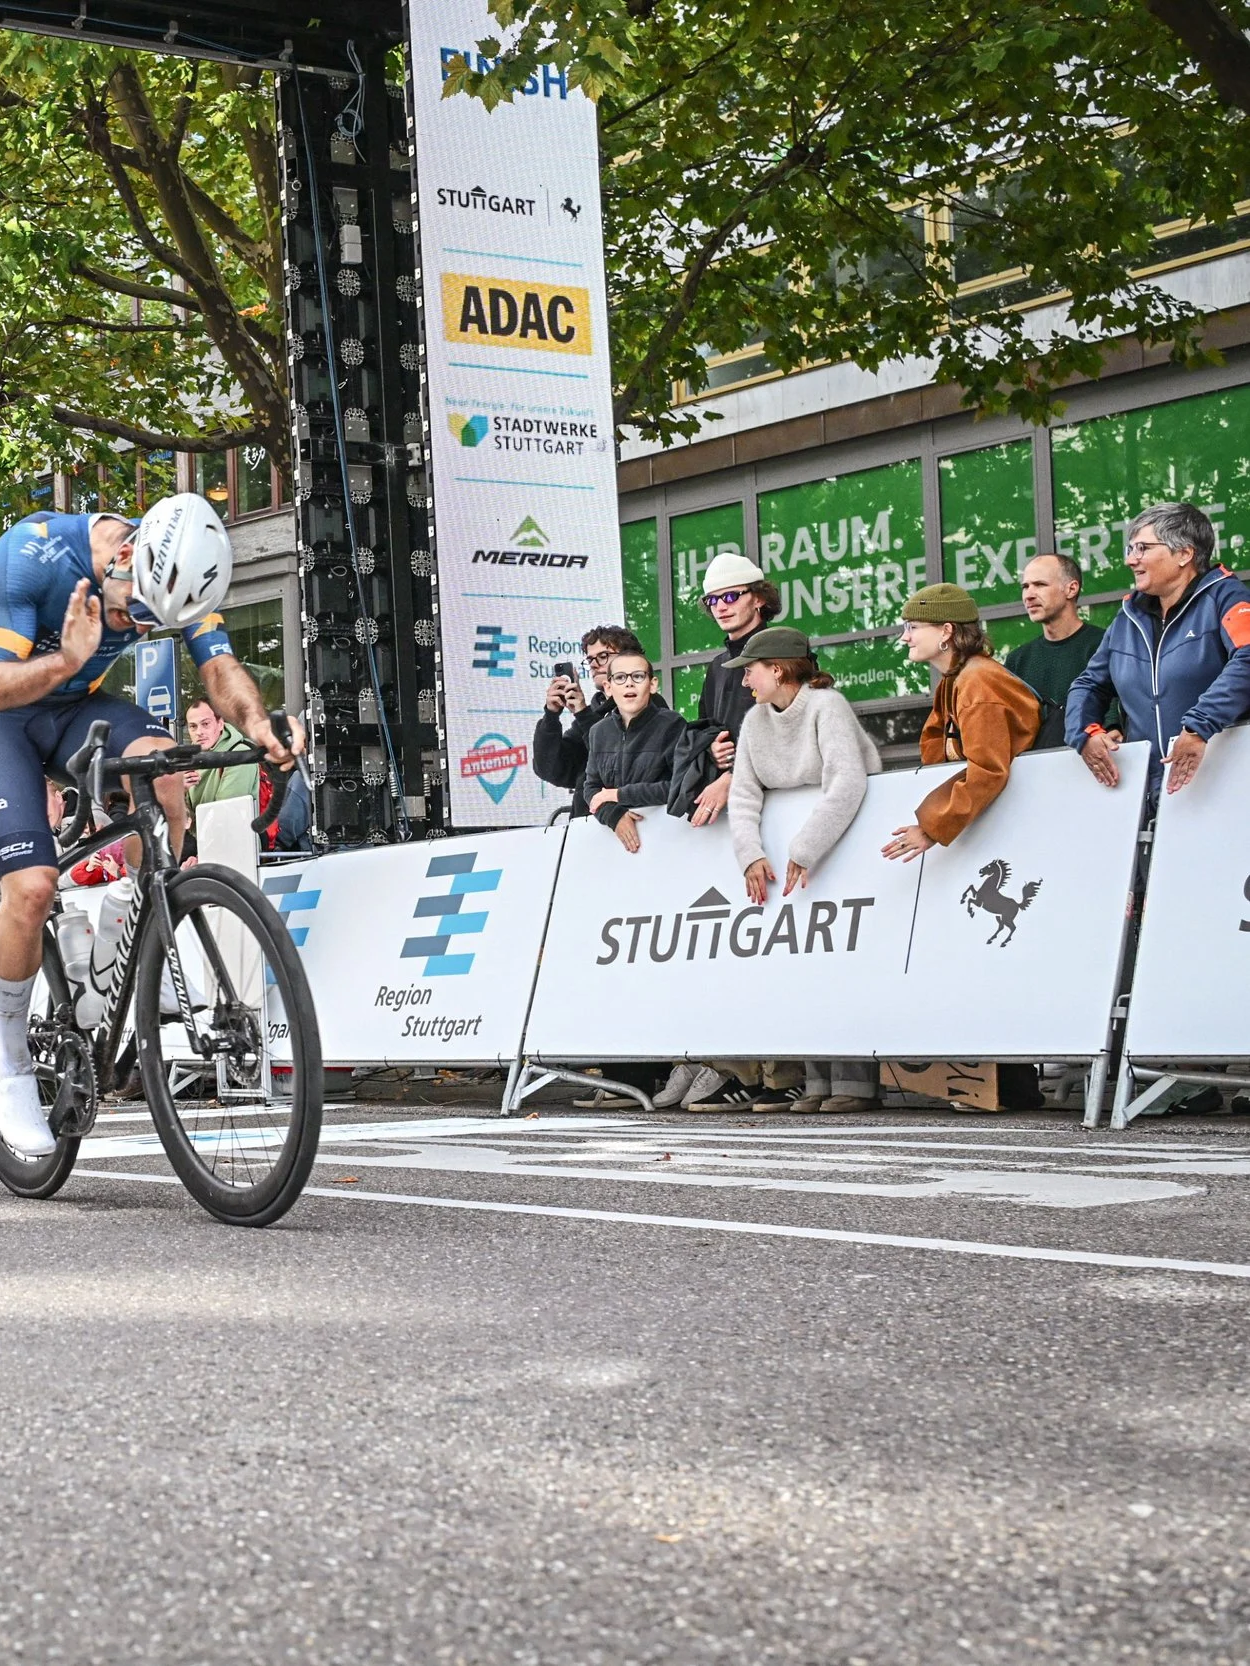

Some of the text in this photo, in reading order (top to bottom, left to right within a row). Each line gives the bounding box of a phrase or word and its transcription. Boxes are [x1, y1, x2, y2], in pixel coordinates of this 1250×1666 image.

[437, 186, 536, 217] STUTTGART
[459, 285, 576, 344] ADAC
[493, 416, 598, 438] STADTWERKE
[493, 435, 585, 456] STUTTGART
[762, 510, 904, 575] RAUM.
[471, 549, 590, 570] MERIDA
[528, 635, 582, 658] Region
[142, 647, 159, 680] P
[463, 748, 527, 774] antenne 1
[596, 888, 876, 966] STUTTGART
[100, 879, 144, 1040] SPECIALIZED
[166, 944, 195, 1032] SPECIALIZED
[374, 983, 433, 1012] Region
[401, 1014, 483, 1043] Stuttgart
